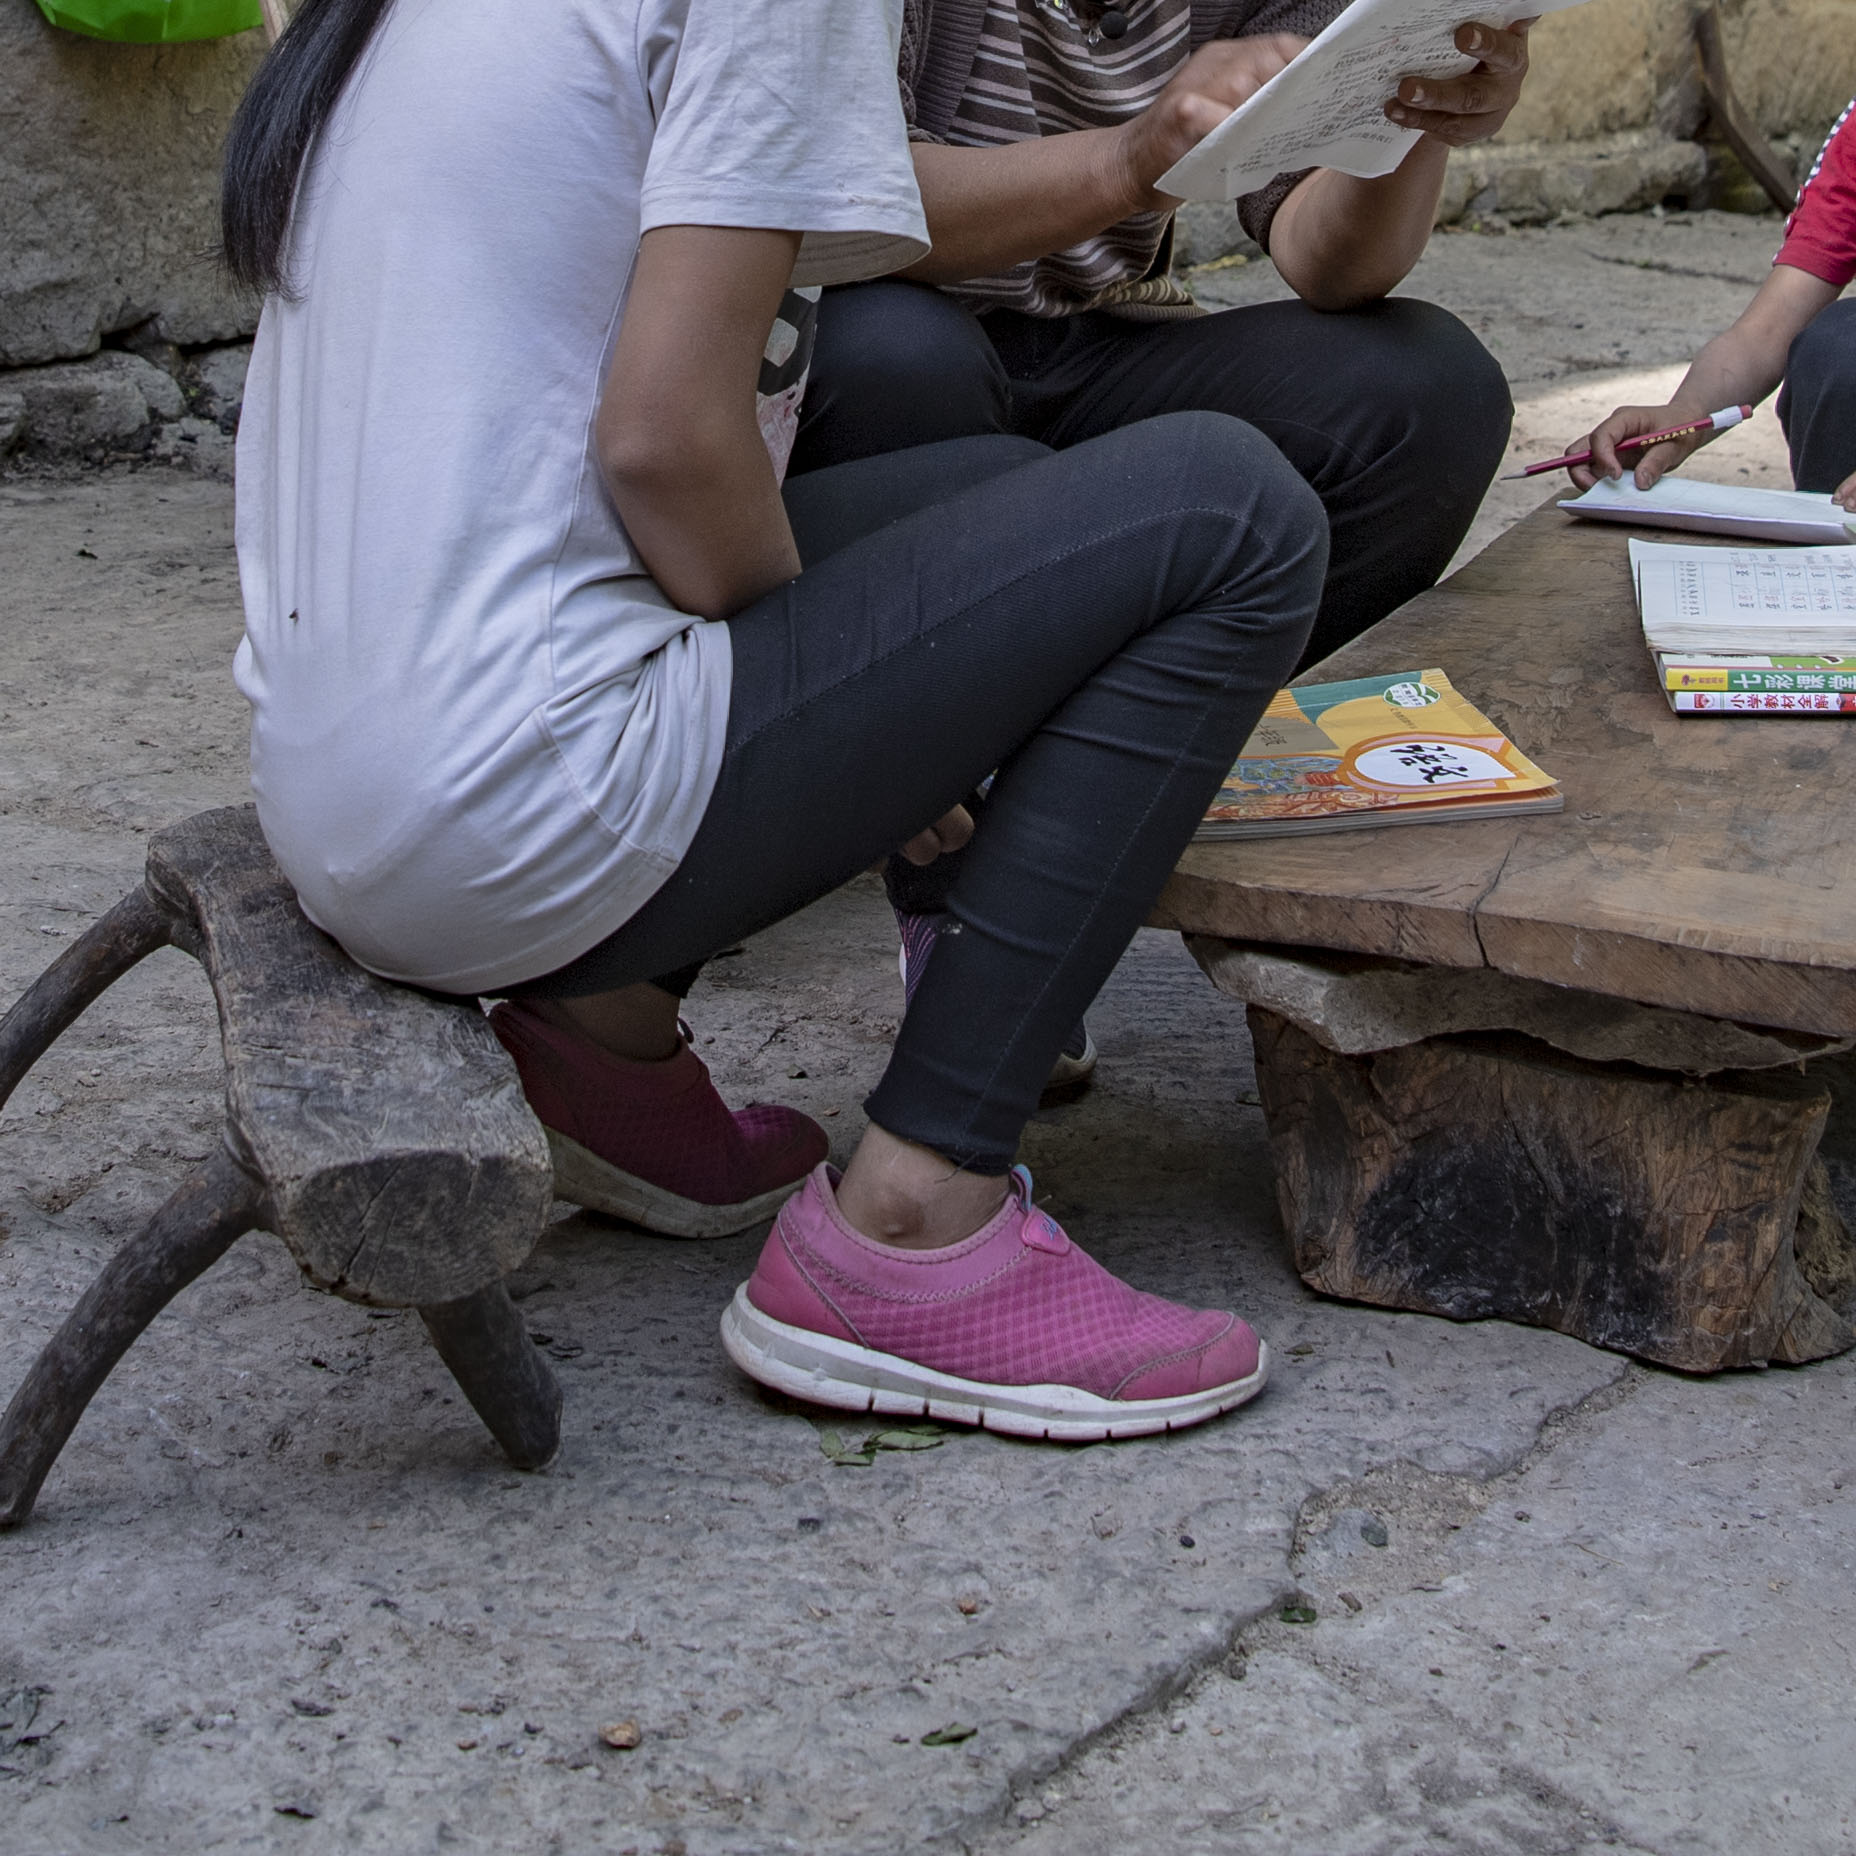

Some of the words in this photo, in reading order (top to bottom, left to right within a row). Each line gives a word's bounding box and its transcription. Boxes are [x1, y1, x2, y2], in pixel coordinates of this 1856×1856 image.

[1731, 694, 1830, 709] 小学教材全解
[1389, 744, 1470, 785] 语文
